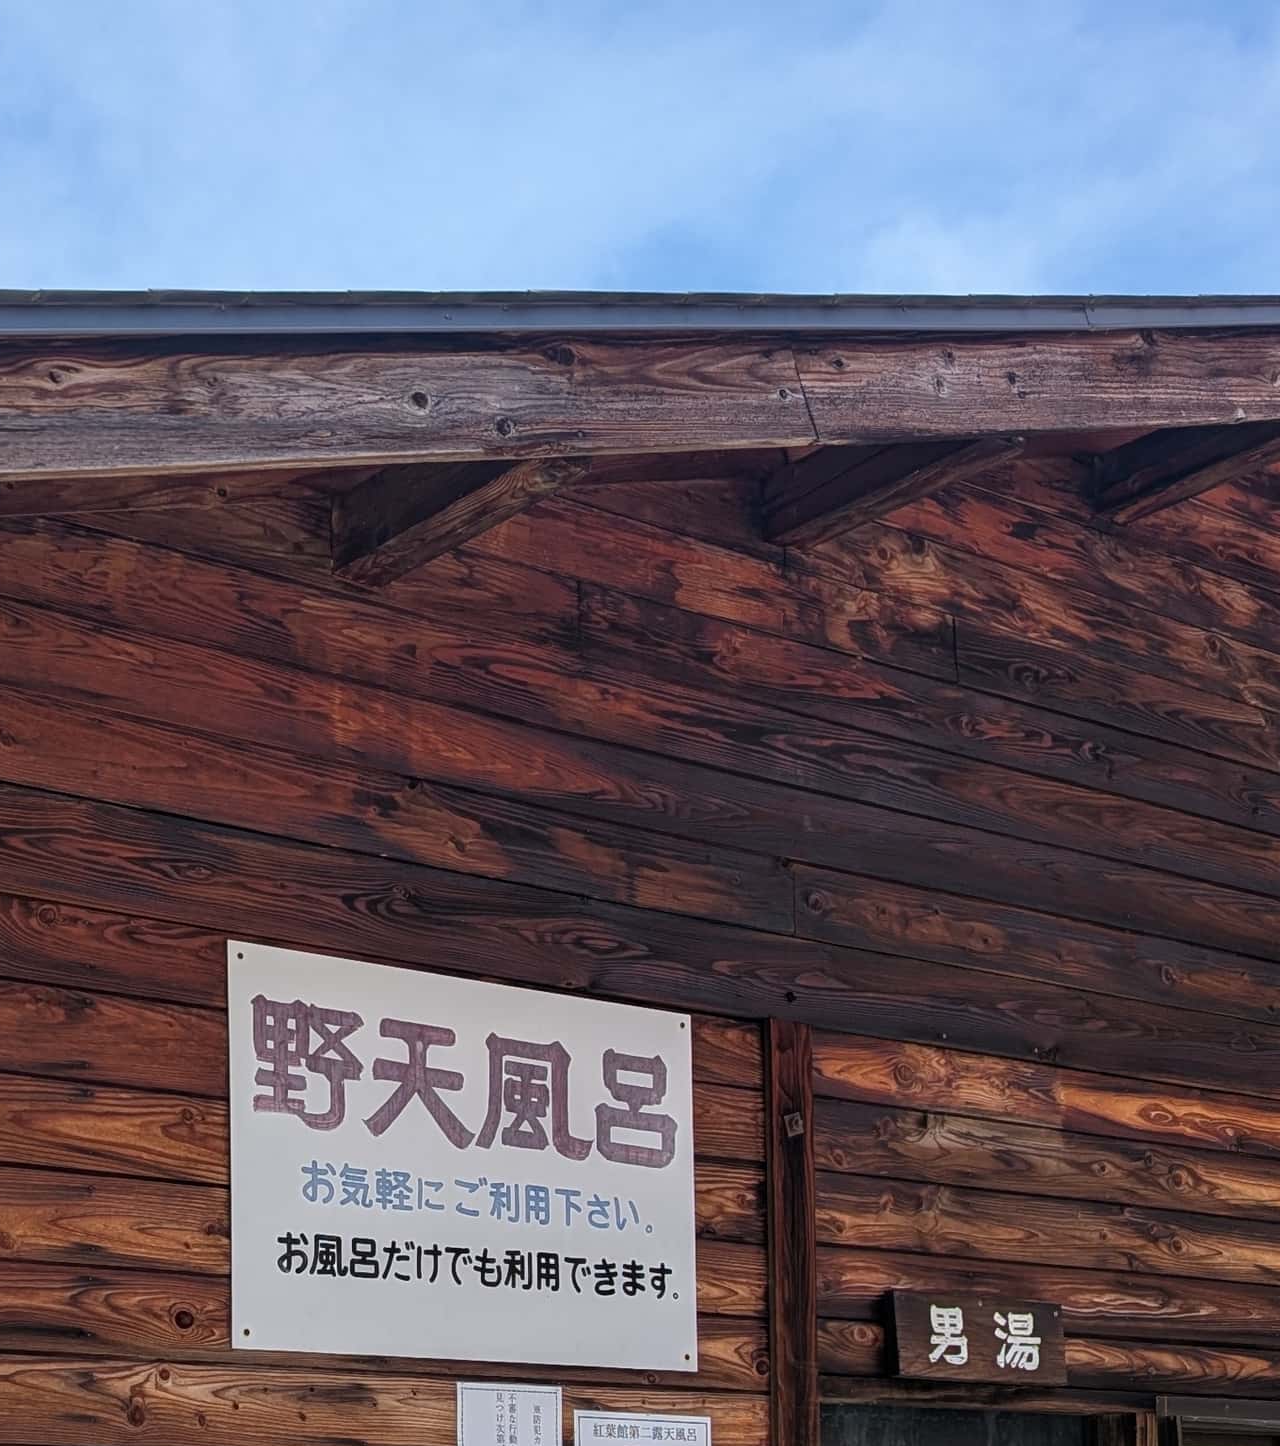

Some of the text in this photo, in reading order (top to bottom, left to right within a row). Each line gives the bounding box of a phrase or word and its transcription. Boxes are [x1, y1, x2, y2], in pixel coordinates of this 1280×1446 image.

[251, 995, 678, 1168] 野天風呂
[300, 1160, 653, 1233] お気軽にご利用下さい。
[277, 1233, 679, 1300] お風呂だけでも利用できます。
[928, 1303, 1041, 1371] 男湯
[593, 1424, 697, 1441] 紅葉館第二露天風呂
